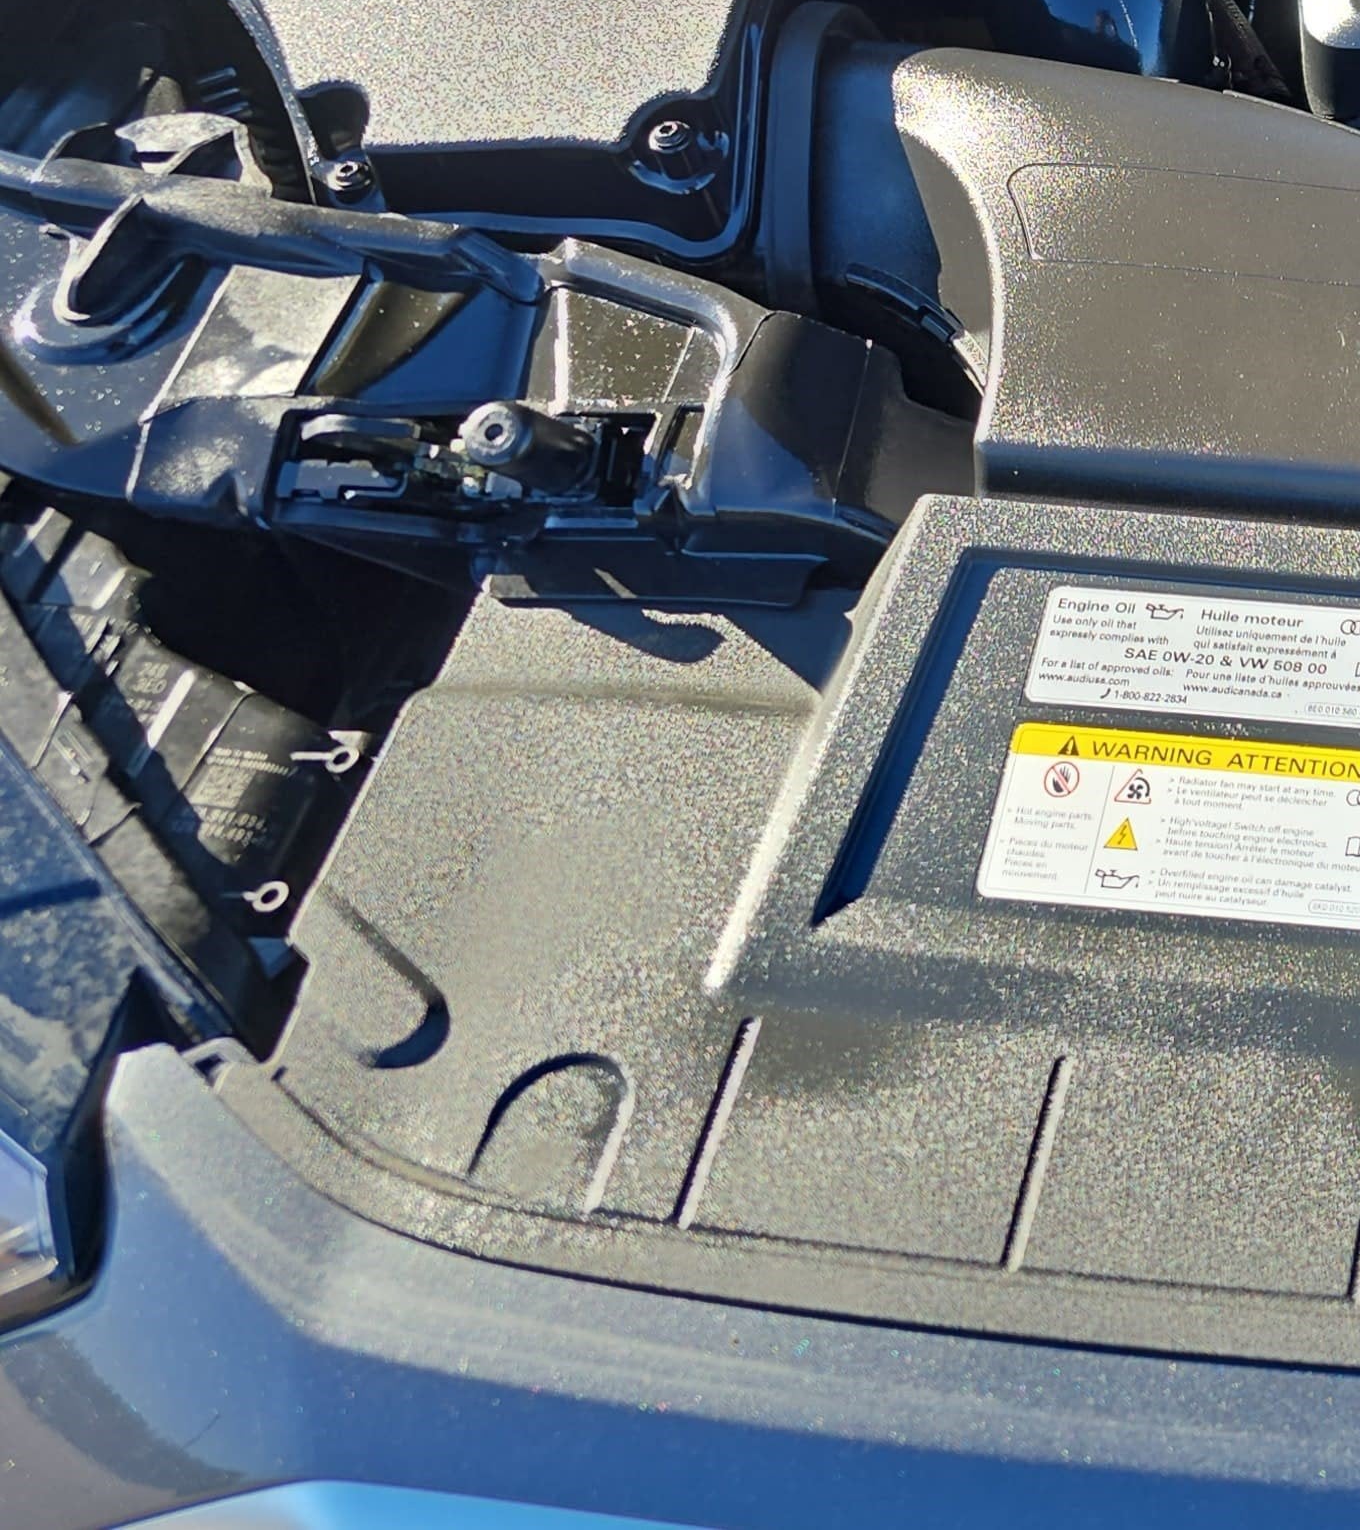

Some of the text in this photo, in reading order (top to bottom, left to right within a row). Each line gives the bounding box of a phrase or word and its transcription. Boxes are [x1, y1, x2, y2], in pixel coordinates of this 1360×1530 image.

[1058, 597, 1136, 614] Engine Oil
[1052, 614, 1136, 629] Use only oil that
[1200, 609, 1303, 627] Huile moteur
[1050, 628, 1168, 645] expressly complies with
[1196, 625, 1232, 637] Utilisez
[1235, 628, 1297, 644] uniquement
[1300, 635, 1312, 644] de
[1193, 639, 1210, 650] qui
[1212, 640, 1252, 652] satisfait
[1040, 656, 1058, 667] For
[1060, 660, 1066, 668] a
[1070, 659, 1085, 669] list
[1088, 660, 1099, 671] of
[1100, 661, 1150, 677] approved
[1124, 646, 1327, 675] SAE 0W-20 & VW 508 00
[1185, 668, 1210, 679] Pour
[1212, 672, 1231, 681] une
[1234, 672, 1256, 683] liste
[1092, 740, 1212, 766] WARNING
[1178, 776, 1216, 787] Radiator
[1220, 779, 1234, 789] fan
[1236, 782, 1256, 792] may
[1260, 783, 1280, 792] start
[1282, 785, 1291, 793] at
[1294, 787, 1310, 796] any
[1182, 797, 1201, 806] tout
